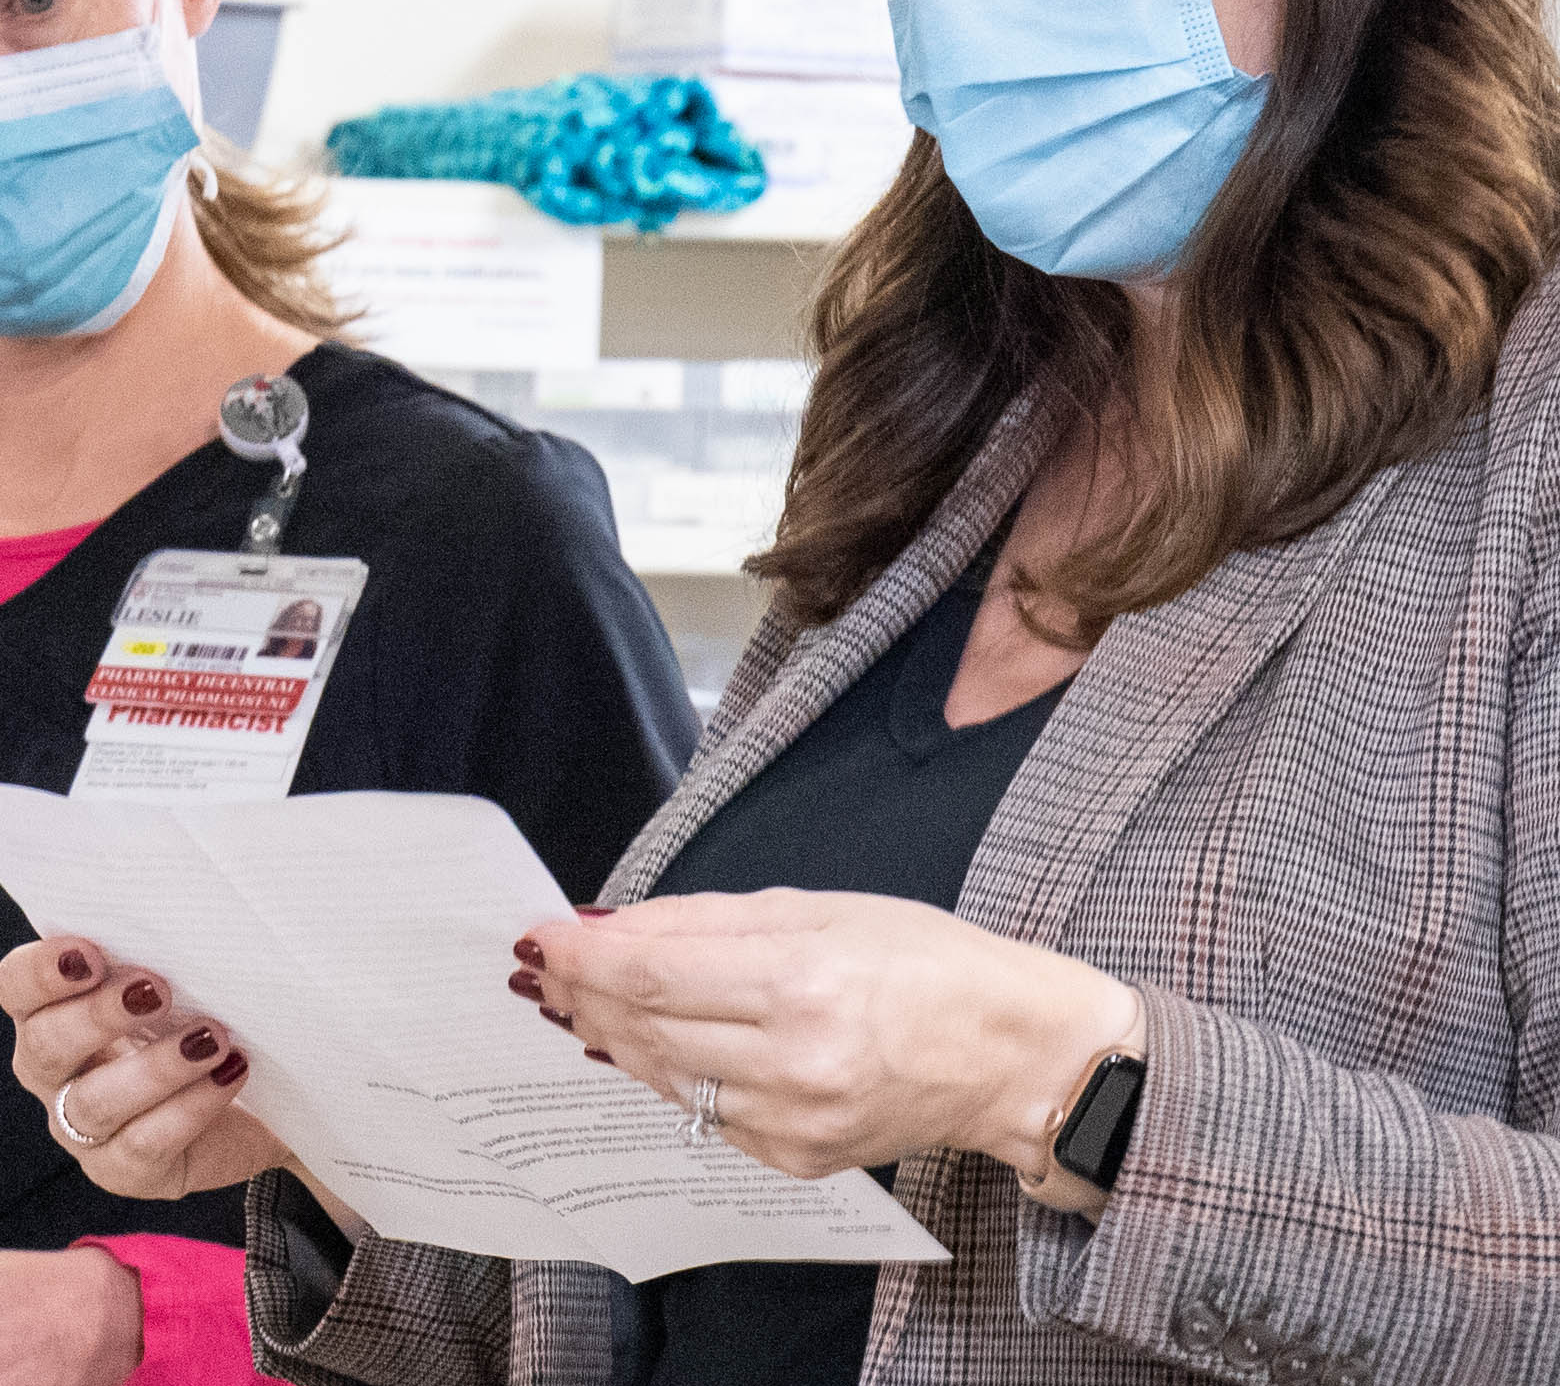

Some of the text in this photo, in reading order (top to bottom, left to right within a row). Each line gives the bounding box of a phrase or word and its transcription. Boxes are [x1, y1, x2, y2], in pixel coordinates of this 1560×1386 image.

[97, 667, 192, 686] PHARMACY
[88, 684, 160, 702] CLINICAL
[107, 705, 289, 734] Pharmacist
